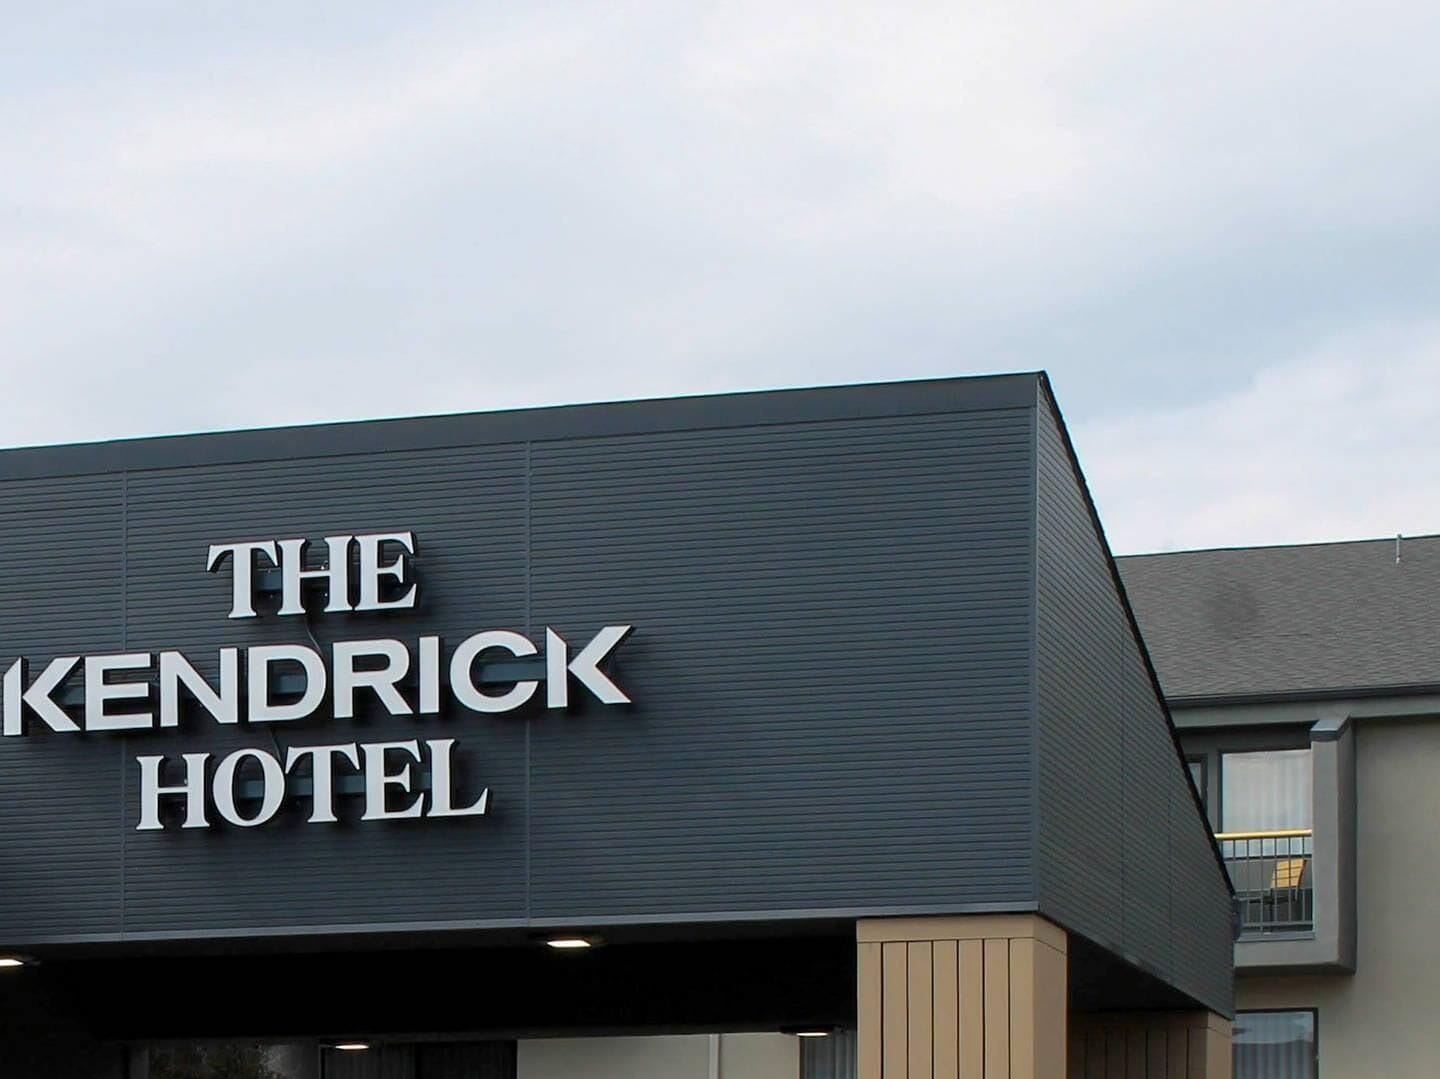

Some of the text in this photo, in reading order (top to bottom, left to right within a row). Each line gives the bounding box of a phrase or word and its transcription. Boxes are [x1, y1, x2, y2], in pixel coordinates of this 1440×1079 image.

[206, 531, 417, 619] THE
[3, 624, 633, 737] KENDRICK
[135, 738, 490, 831] HOTEL
